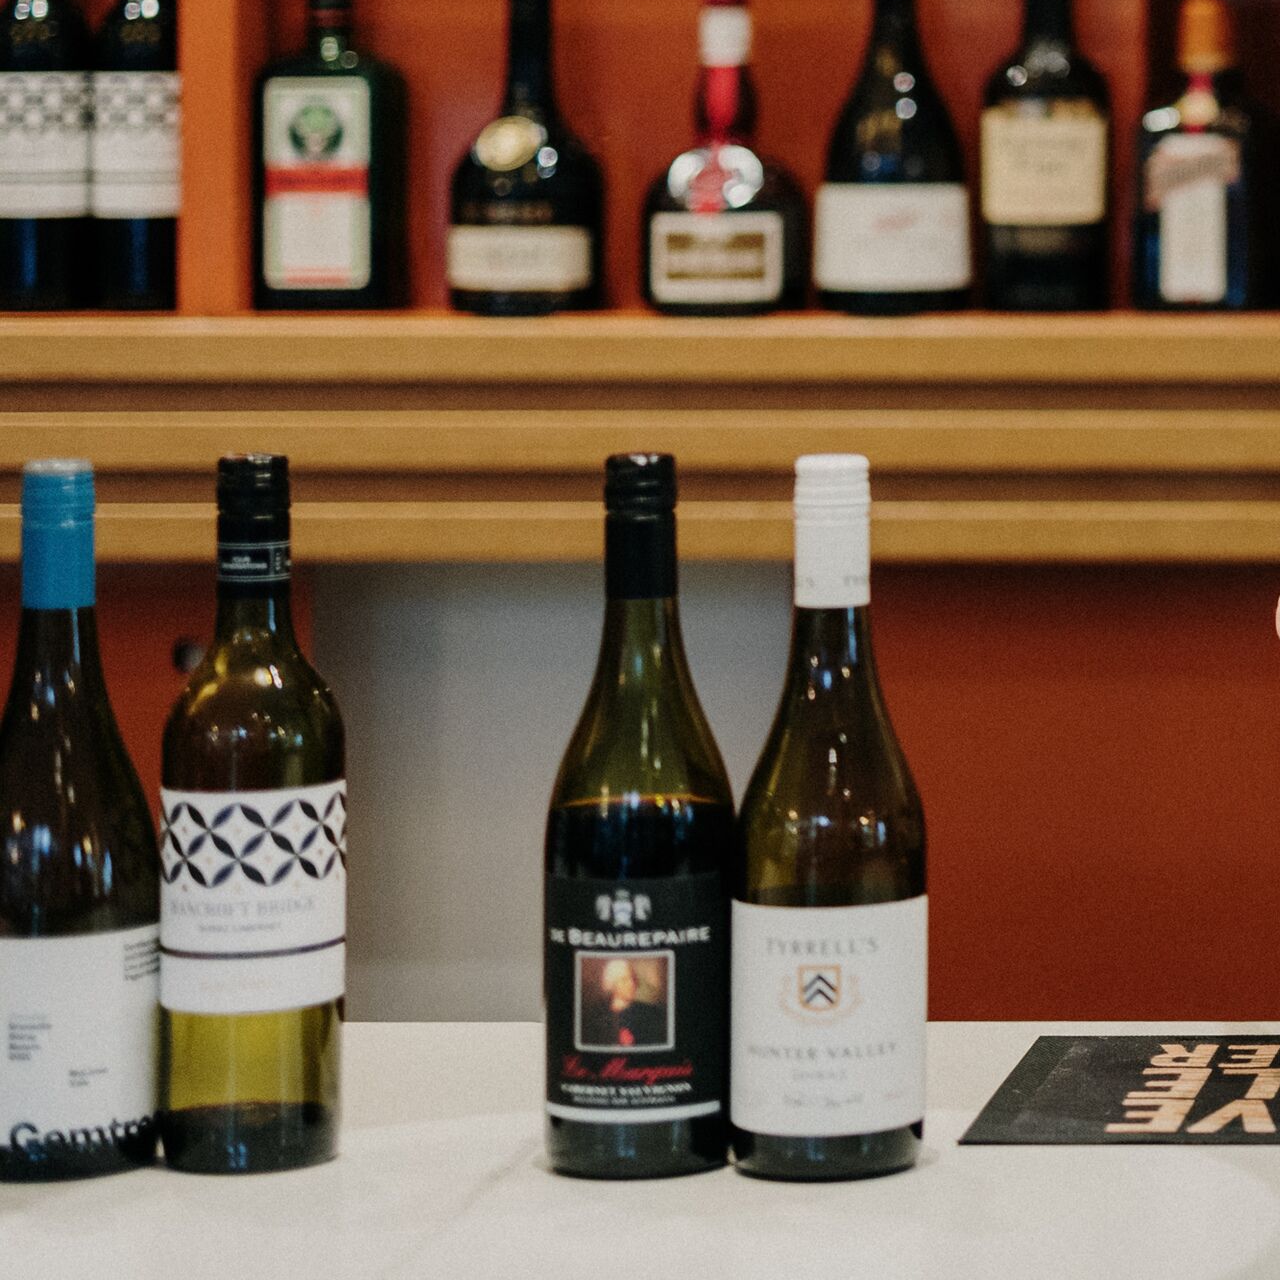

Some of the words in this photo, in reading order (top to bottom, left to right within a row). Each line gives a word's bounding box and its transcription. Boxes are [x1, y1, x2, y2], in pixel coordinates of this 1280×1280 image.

[568, 925, 711, 948] BEAUREPAIRE
[766, 937, 879, 956] TYRRELL'S
[826, 1041, 898, 1059] VALLEY
